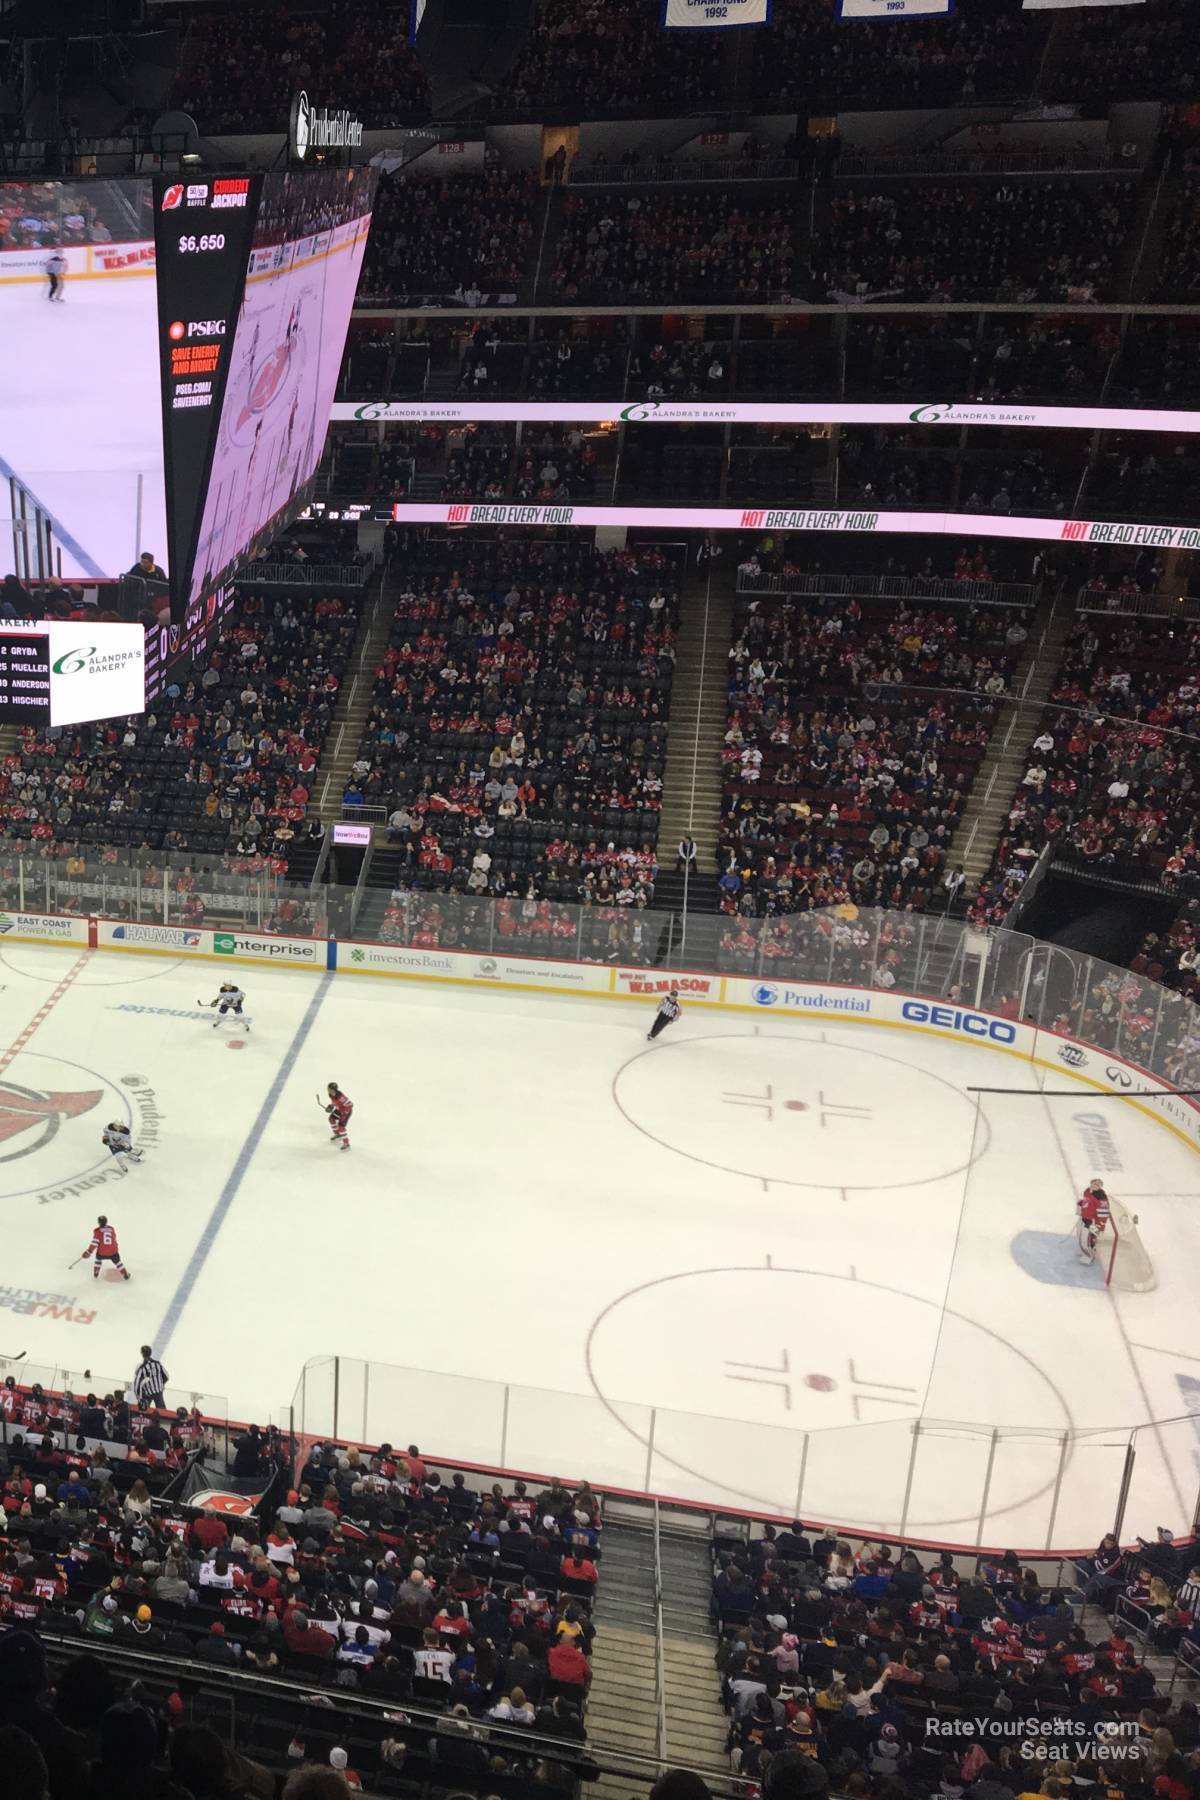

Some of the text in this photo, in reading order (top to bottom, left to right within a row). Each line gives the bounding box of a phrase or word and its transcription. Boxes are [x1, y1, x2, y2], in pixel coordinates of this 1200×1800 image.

[705, 7, 727, 18] 1992
[886, 2, 905, 10] 1993
[310, 106, 345, 146] Prudential
[706, 135, 722, 143] 127
[444, 144, 460, 152] 128
[211, 193, 247, 208] JACKPOT
[179, 234, 225, 253] $6,650
[188, 320, 226, 337] PSEG
[172, 344, 220, 360] SAVE ENERGY
[172, 359, 218, 374] AND MONEY
[173, 394, 213, 408] SAVEENERGY
[999, 413, 1036, 421] BAKERY
[448, 505, 574, 523] HOT BREAD EVERY HOUR
[740, 511, 879, 529] HOT BREAD EVERY HOUR
[1061, 521, 1090, 540] HOT
[1089, 523, 1135, 542] BREAD
[1135, 526, 1177, 546] EVERY
[1, 647, 37, 656] 2 GRYBA
[11, 663, 48, 673] MUELLER
[89, 661, 126, 674] BAKERY
[12, 679, 50, 689] ANDERSON
[0, 695, 49, 706] 13 HISCHIER
[17, 916, 71, 929] EAST COAST
[17, 926, 45, 936] POWER
[124, 925, 185, 946] HALMAR
[215, 937, 314, 957] enterprise
[784, 990, 871, 1013] Prudential
[902, 1001, 1016, 1044] GEICO
[37, 1168, 127, 1204] Center
[103, 1231, 112, 1245] 6
[423, 1661, 443, 1680] 15
